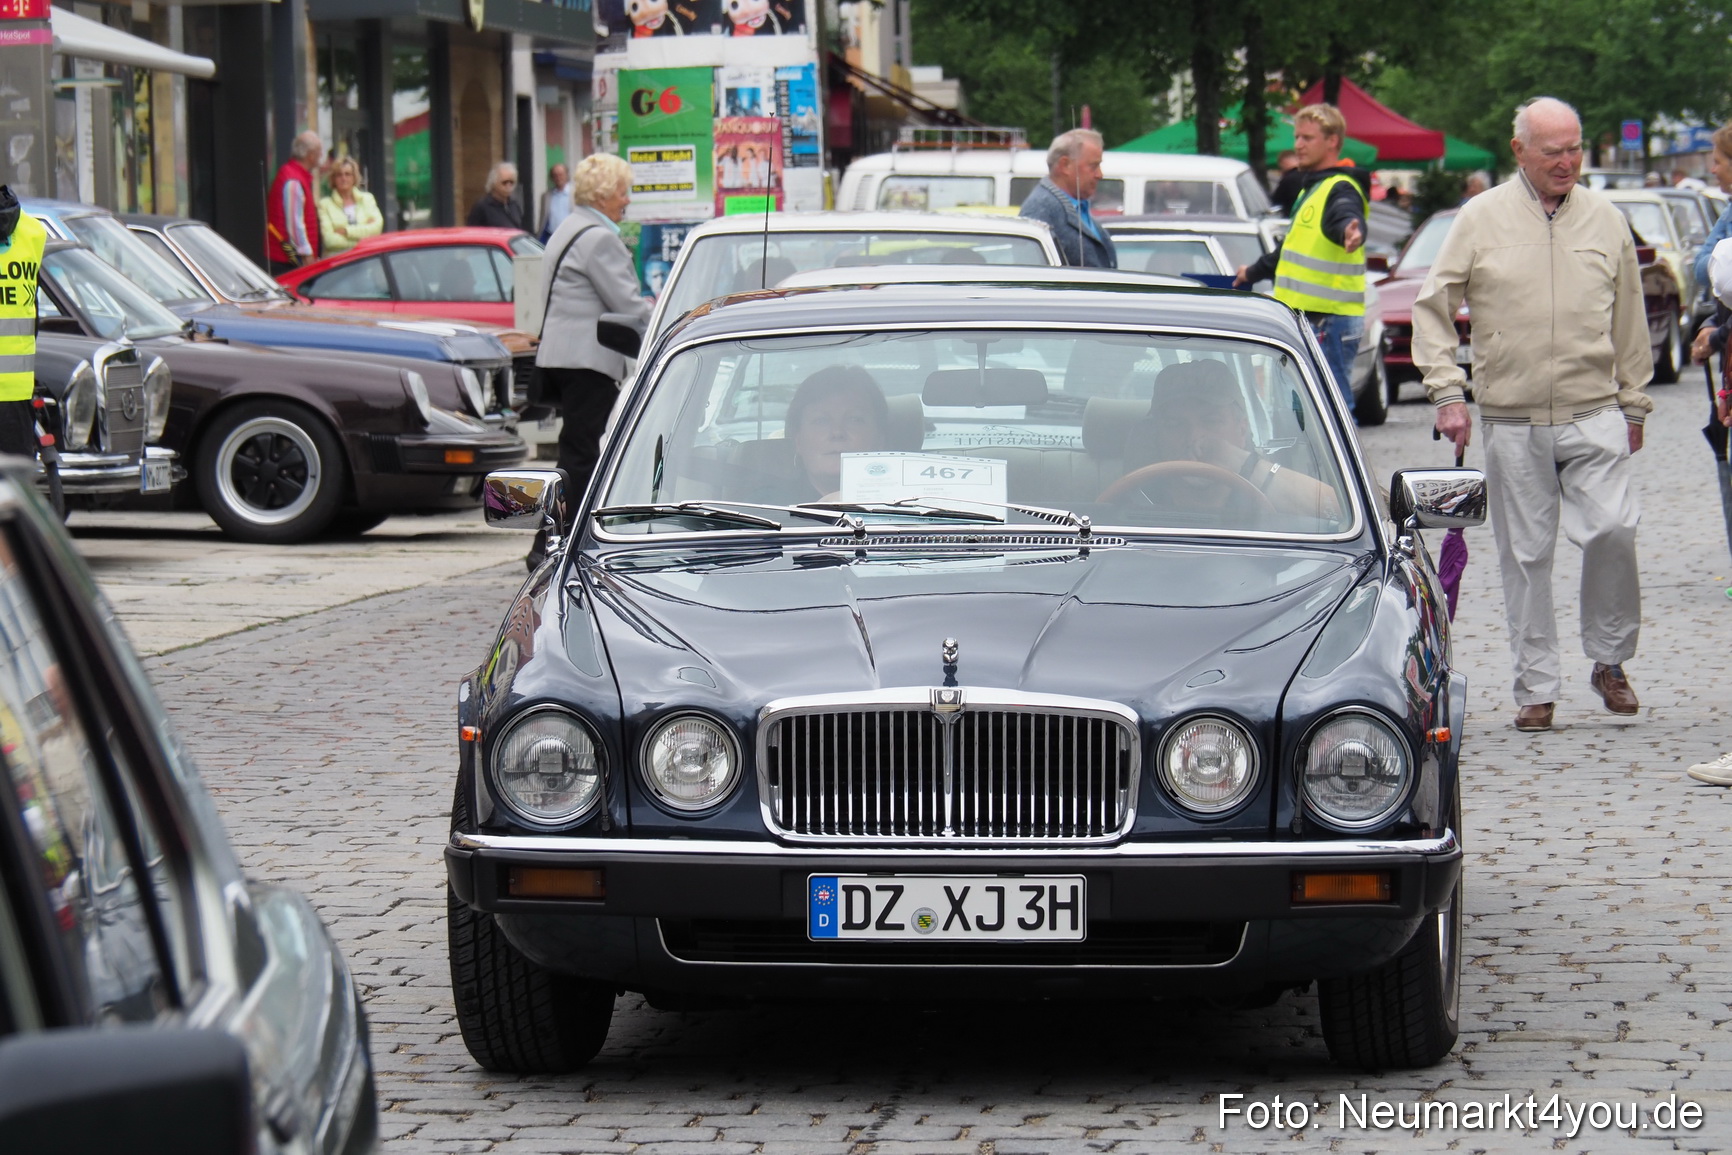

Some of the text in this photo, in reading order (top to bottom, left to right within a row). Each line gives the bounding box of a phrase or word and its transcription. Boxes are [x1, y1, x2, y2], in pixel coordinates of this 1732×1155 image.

[630, 86, 682, 117] G6
[920, 466, 974, 479] 467
[841, 884, 905, 931] DZ
[942, 885, 1005, 931] XJ
[1017, 885, 1079, 931] 3H
[819, 914, 829, 927] D
